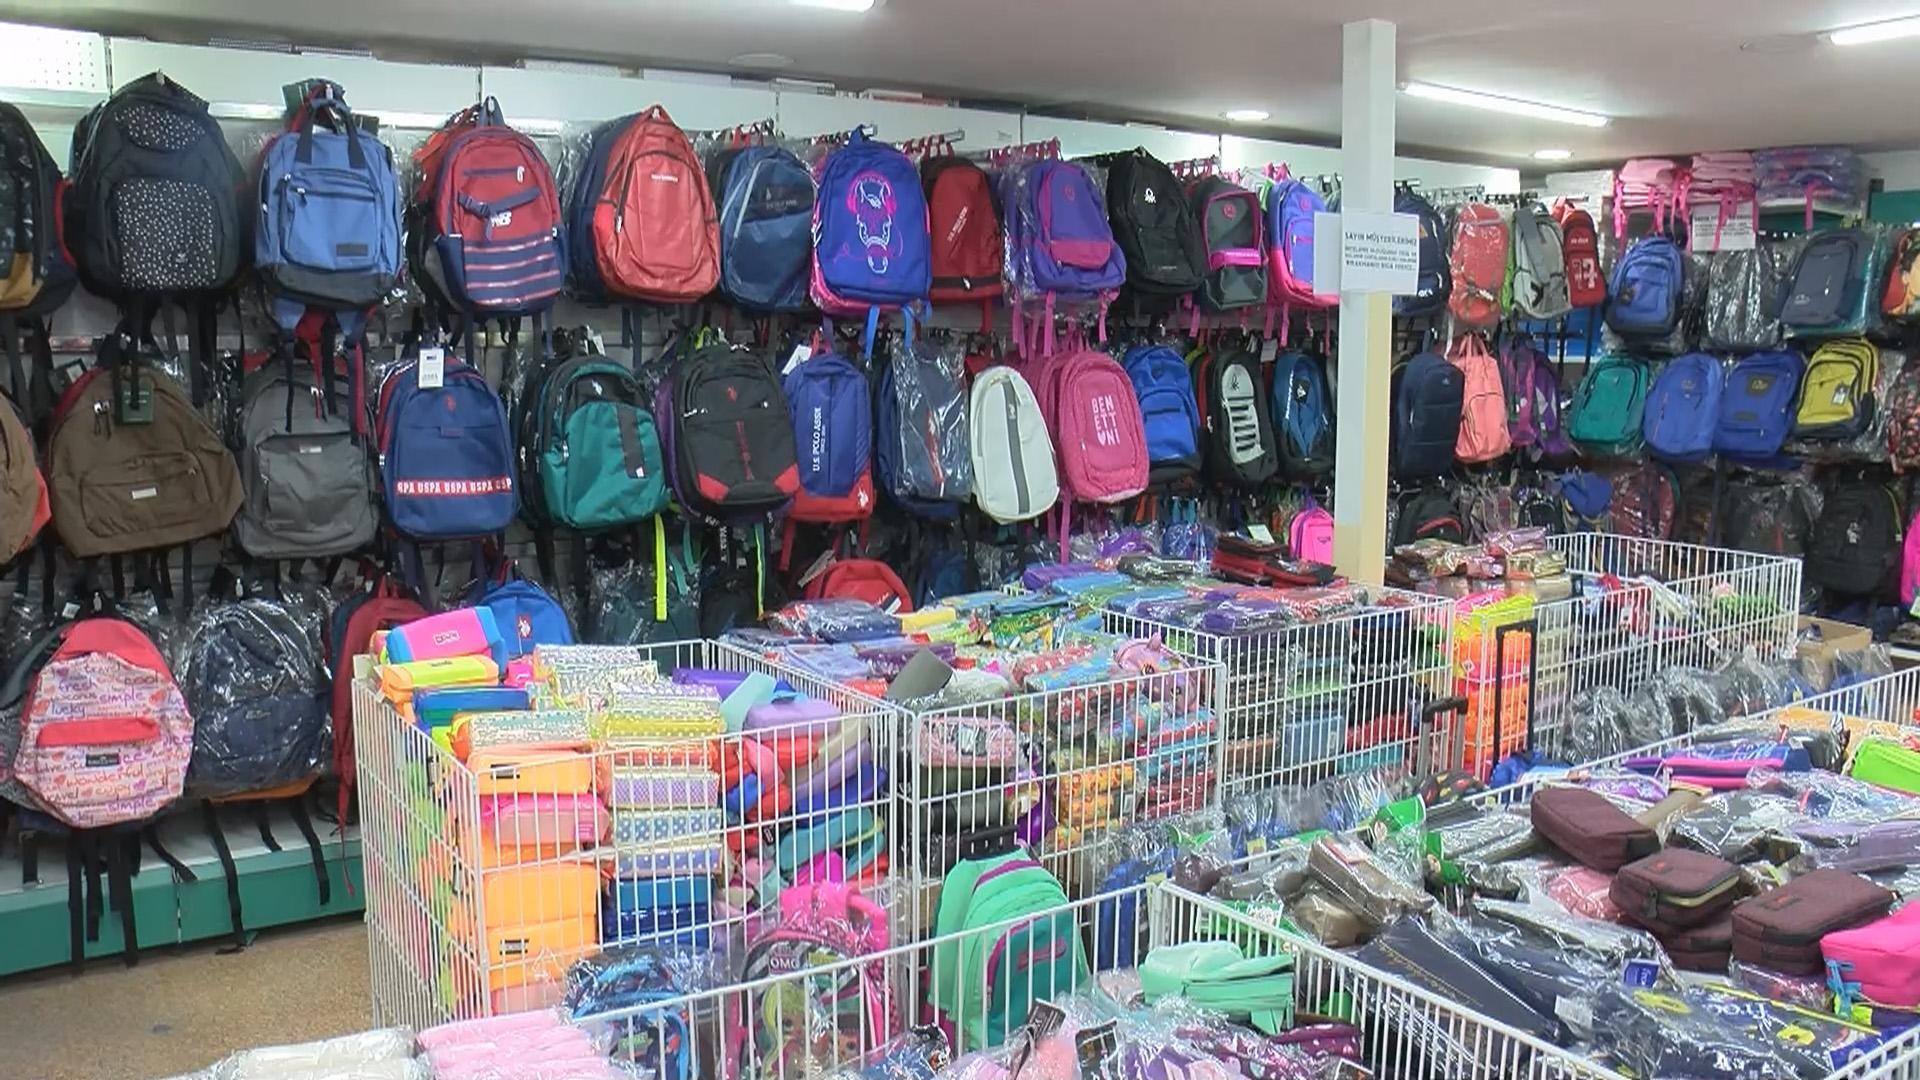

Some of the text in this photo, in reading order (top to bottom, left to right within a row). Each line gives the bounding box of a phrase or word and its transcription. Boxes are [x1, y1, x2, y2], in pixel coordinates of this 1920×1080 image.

[1091, 395, 1114, 414] BEN
[1093, 411, 1117, 431] ETT
[812, 431, 821, 455] POLO
[397, 477, 512, 494] SPA USPA USPA USPA USP
[99, 686, 146, 707] simple
[107, 796, 158, 815] simple
